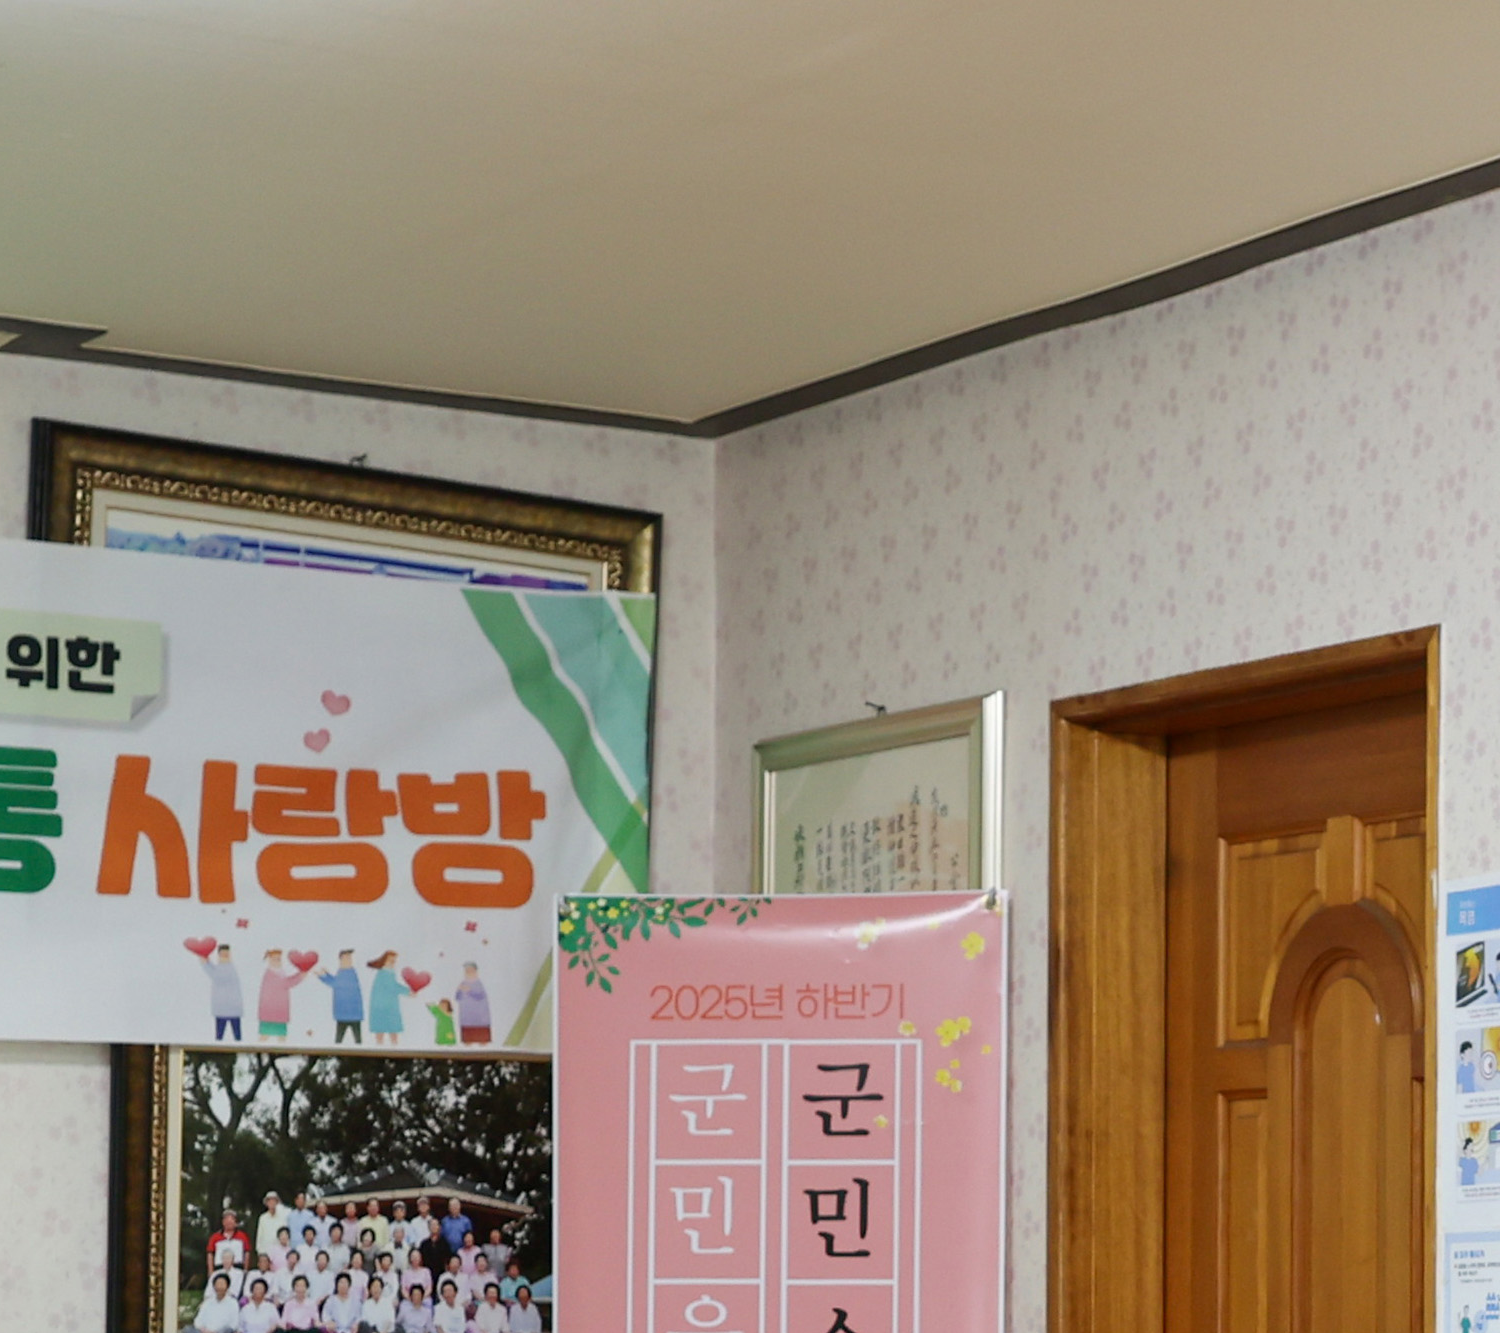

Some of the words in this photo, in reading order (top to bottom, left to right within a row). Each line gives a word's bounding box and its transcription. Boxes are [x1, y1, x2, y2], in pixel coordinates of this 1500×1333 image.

[4, 632, 121, 697] 위한
[96, 752, 548, 910] 사랑방
[650, 983, 784, 1021] 2025년
[796, 982, 905, 1020] 하반기
